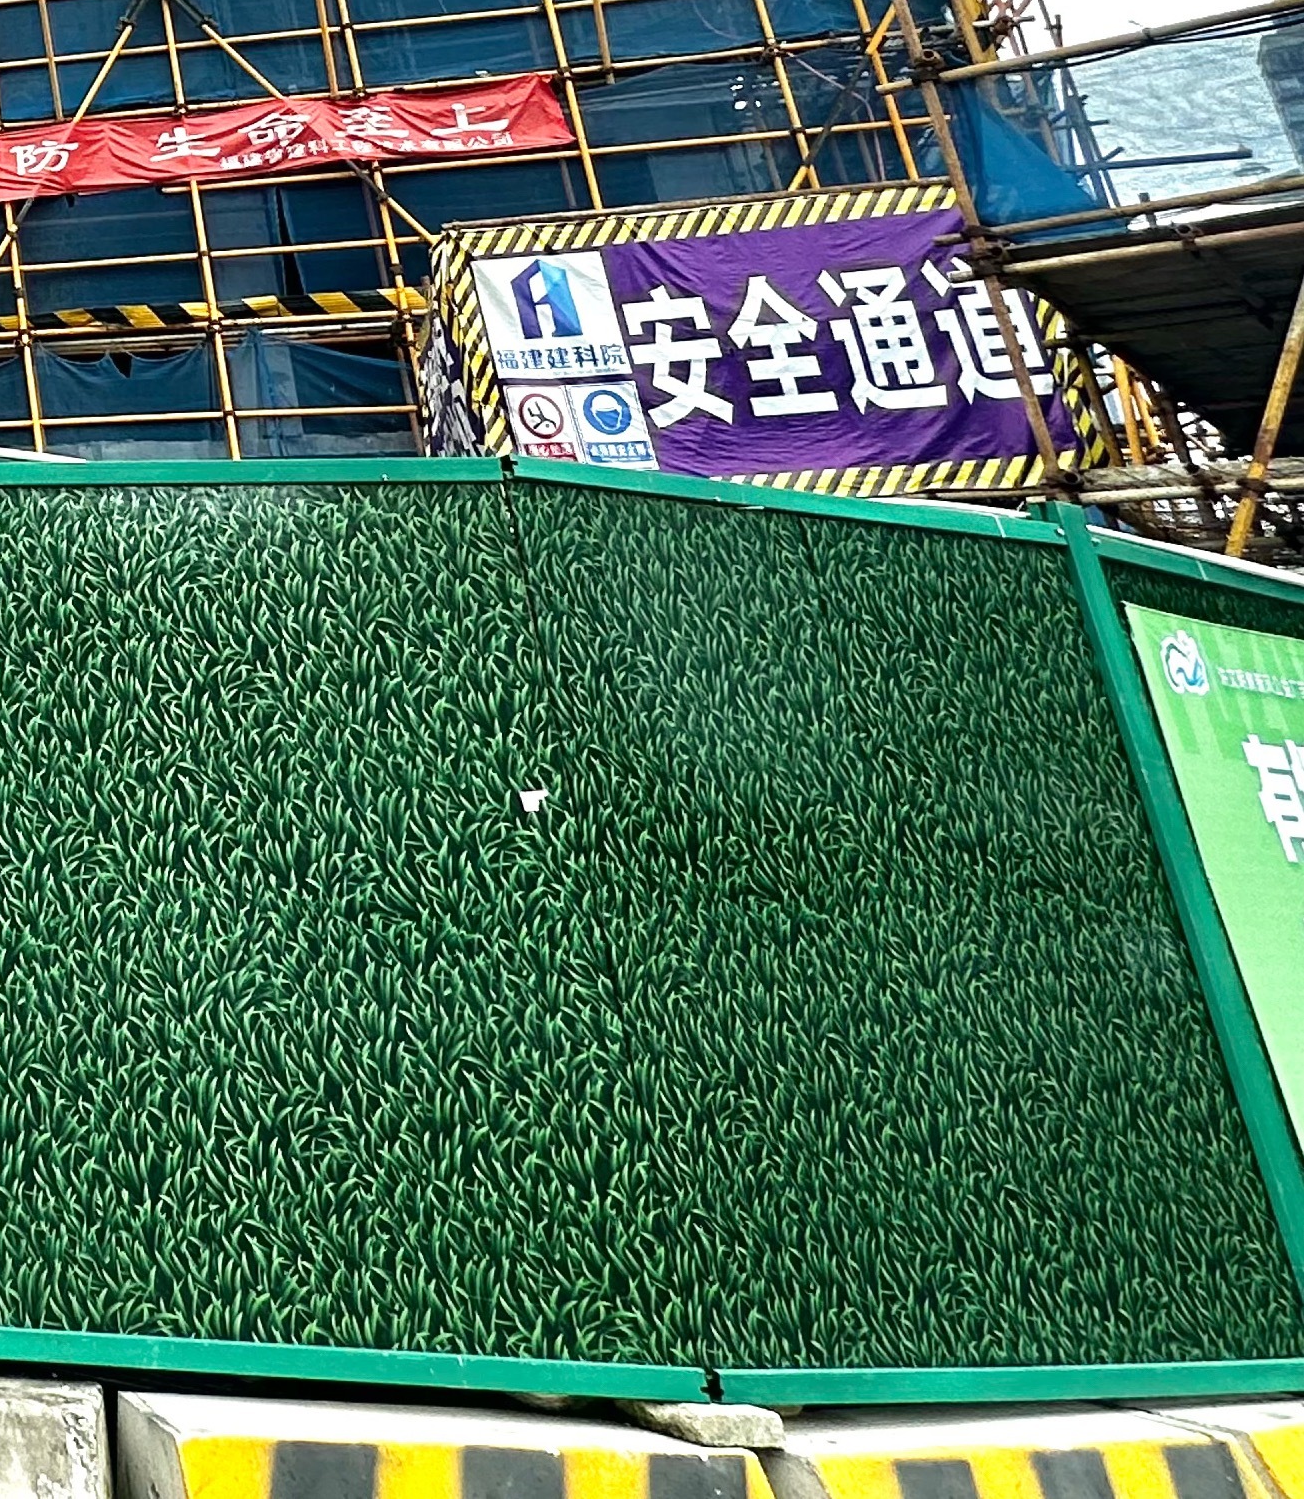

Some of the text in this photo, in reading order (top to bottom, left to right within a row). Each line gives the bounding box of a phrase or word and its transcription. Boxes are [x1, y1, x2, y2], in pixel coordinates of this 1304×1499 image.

[149, 102, 511, 164] 生命至上
[496, 343, 627, 370] 福建建科院
[622, 258, 1055, 431] 安全通道
